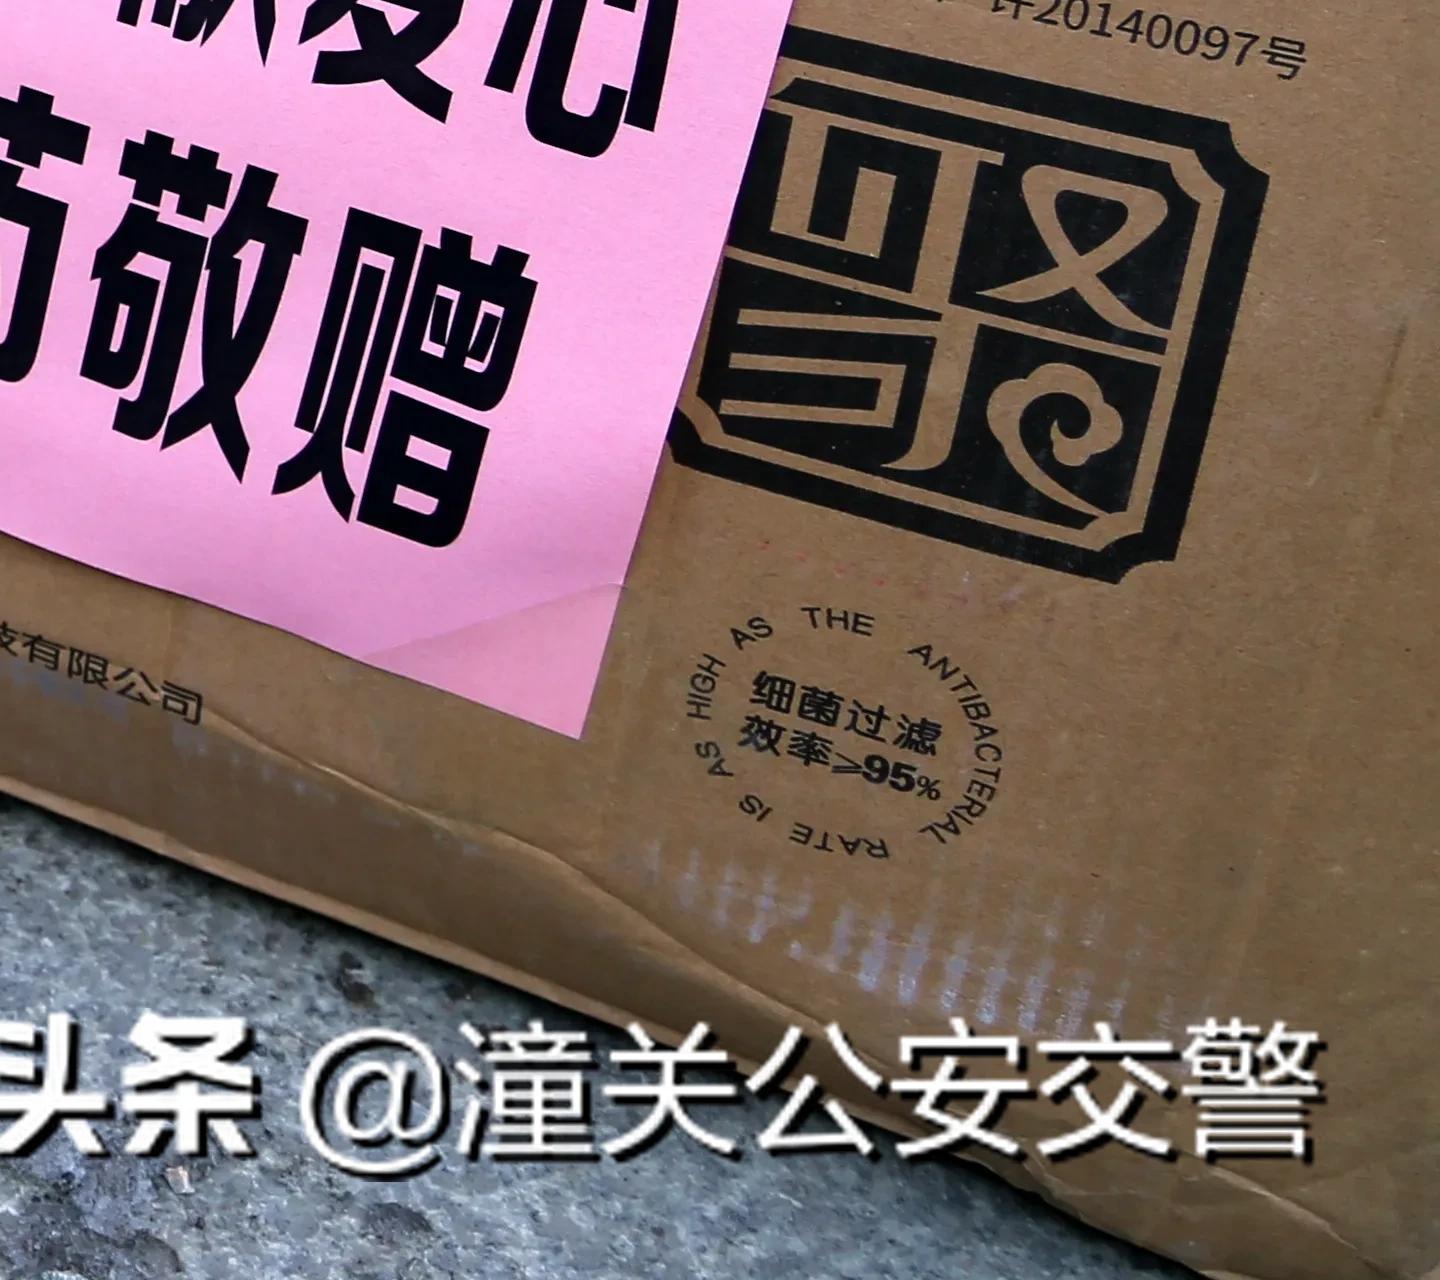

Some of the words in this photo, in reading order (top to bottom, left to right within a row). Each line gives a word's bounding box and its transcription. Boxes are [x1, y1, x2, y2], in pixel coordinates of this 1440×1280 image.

[730, 617, 773, 650] AS
[801, 606, 875, 637] THE
[687, 653, 726, 721] HIGH
[749, 670, 943, 757] 细菌过滤
[695, 741, 735, 778] AS
[907, 644, 1003, 844] ANTIBACTERIAL
[738, 794, 773, 822] IS
[788, 822, 890, 860] RATE
